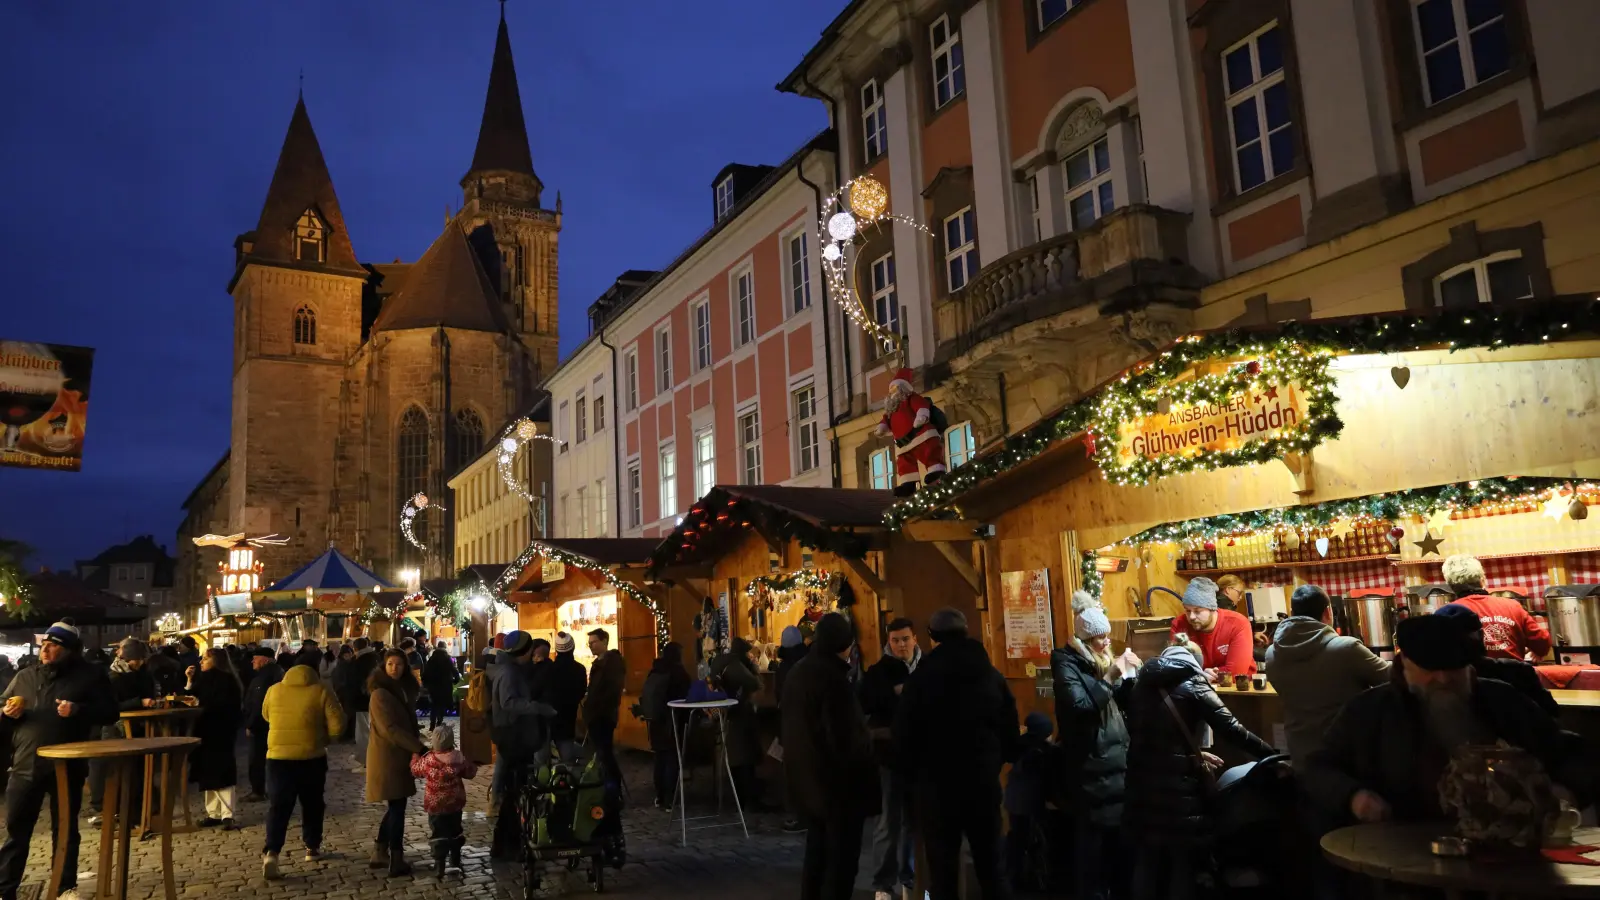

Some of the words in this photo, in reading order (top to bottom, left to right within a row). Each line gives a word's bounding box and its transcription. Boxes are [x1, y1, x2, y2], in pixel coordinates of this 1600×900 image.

[1169, 396, 1246, 425] ANSBACHER
[1131, 404, 1296, 455] Glühwein-Hüddn
[1486, 641, 1510, 651] nsbach
